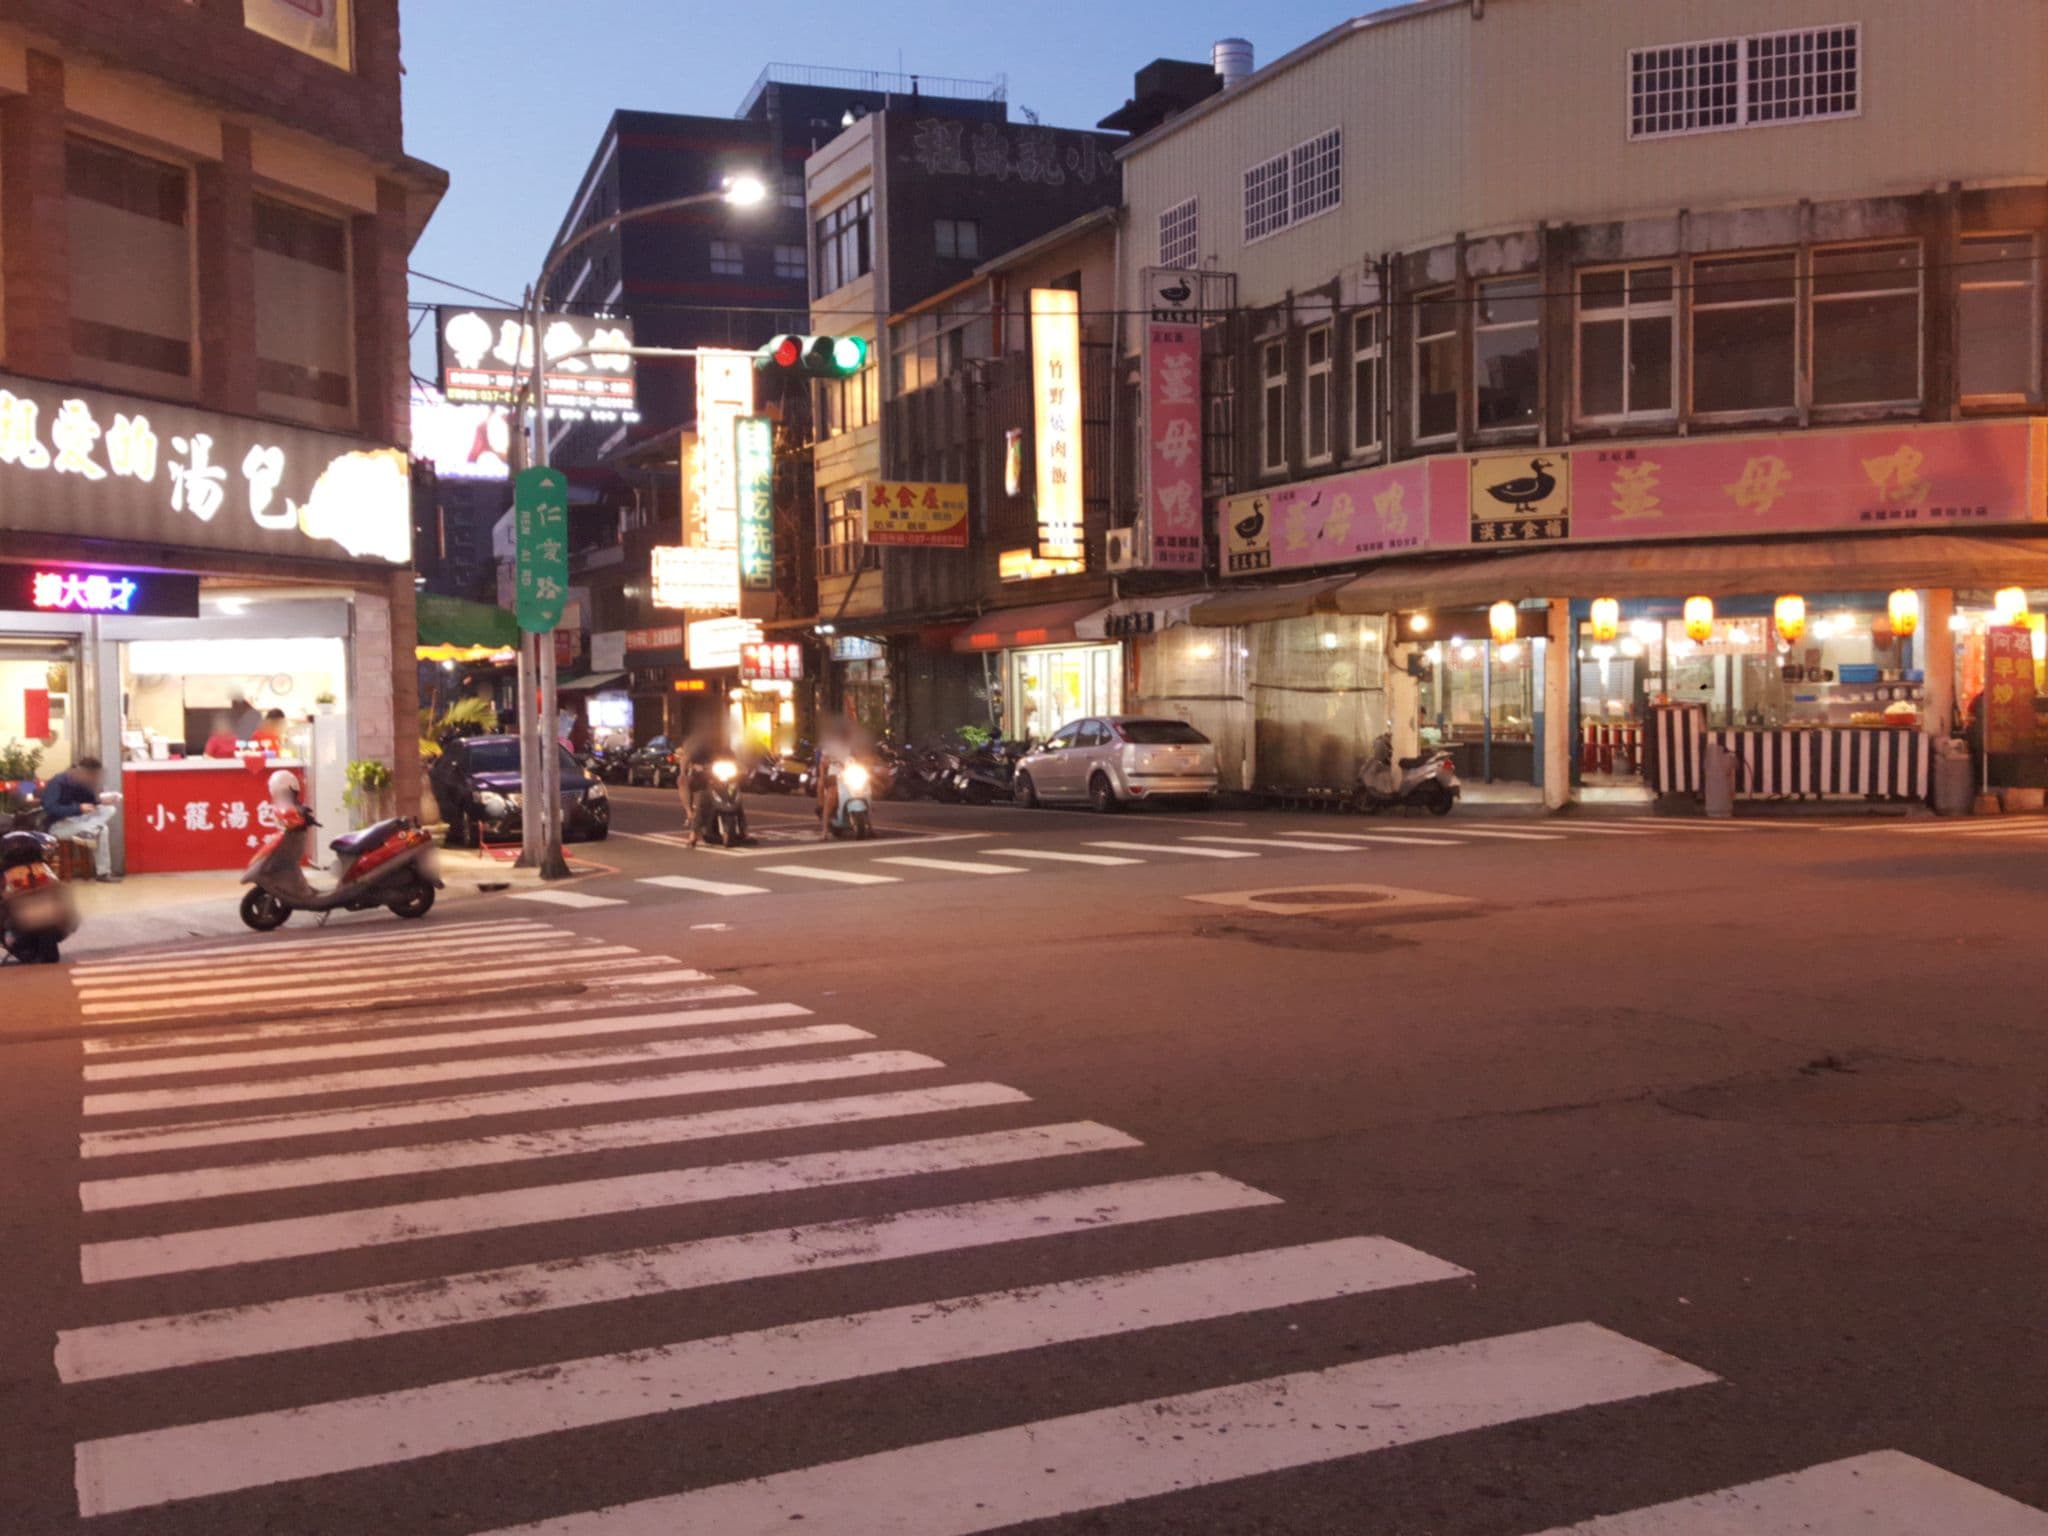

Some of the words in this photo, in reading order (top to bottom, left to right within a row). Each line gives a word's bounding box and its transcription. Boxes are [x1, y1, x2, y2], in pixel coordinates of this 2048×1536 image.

[1153, 351, 1198, 530] 薑母鴨
[1608, 444, 1934, 521] 薑母鴨
[146, 800, 282, 832] 小籠湯包
